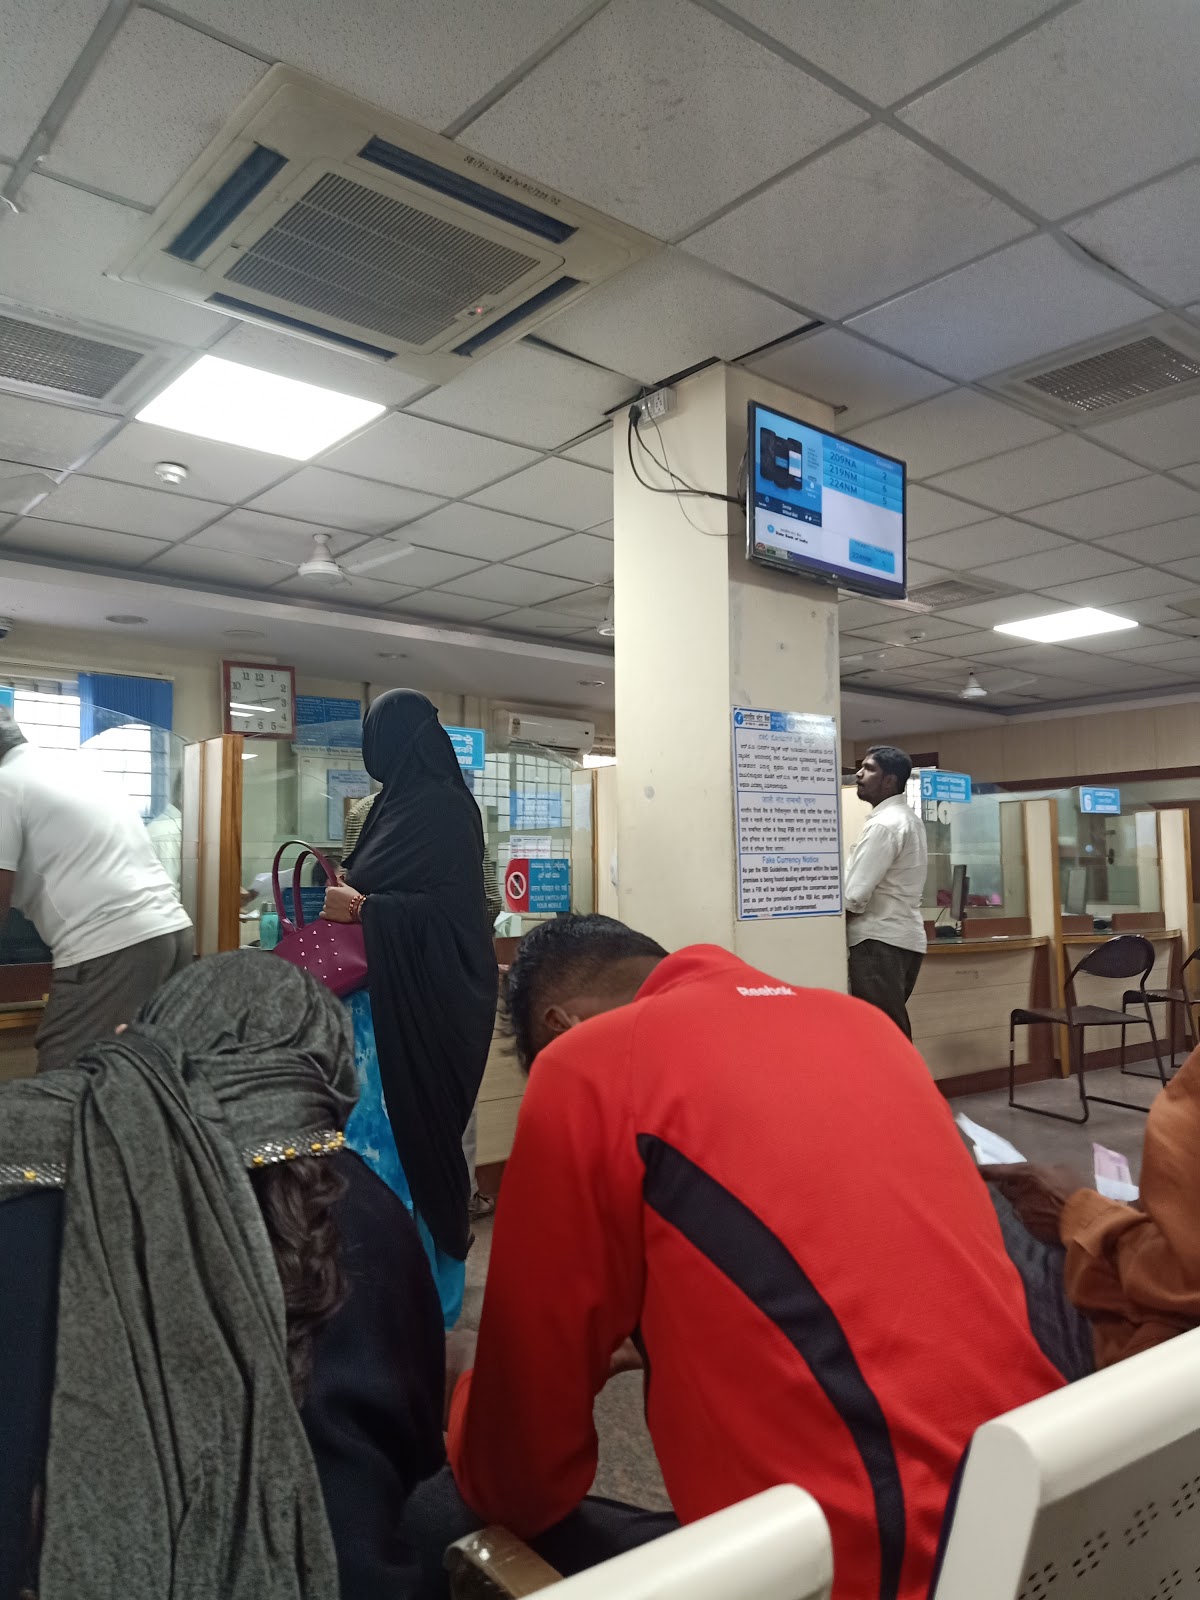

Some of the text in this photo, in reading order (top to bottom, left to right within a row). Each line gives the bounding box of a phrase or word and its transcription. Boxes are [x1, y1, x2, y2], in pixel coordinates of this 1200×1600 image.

[830, 452, 856, 469] 209NA
[883, 472, 887, 480] 2
[830, 464, 887, 493] 219NM 6
[830, 478, 857, 495] 224NM
[883, 497, 887, 505] 5
[255, 673, 264, 681] 12
[281, 684, 286, 692] 2
[281, 699, 286, 707] 3
[282, 713, 286, 721] 4
[271, 722, 276, 730] 5
[923, 777, 932, 796] 5
[1084, 794, 1091, 810] 6
[777, 856, 801, 865] Currency
